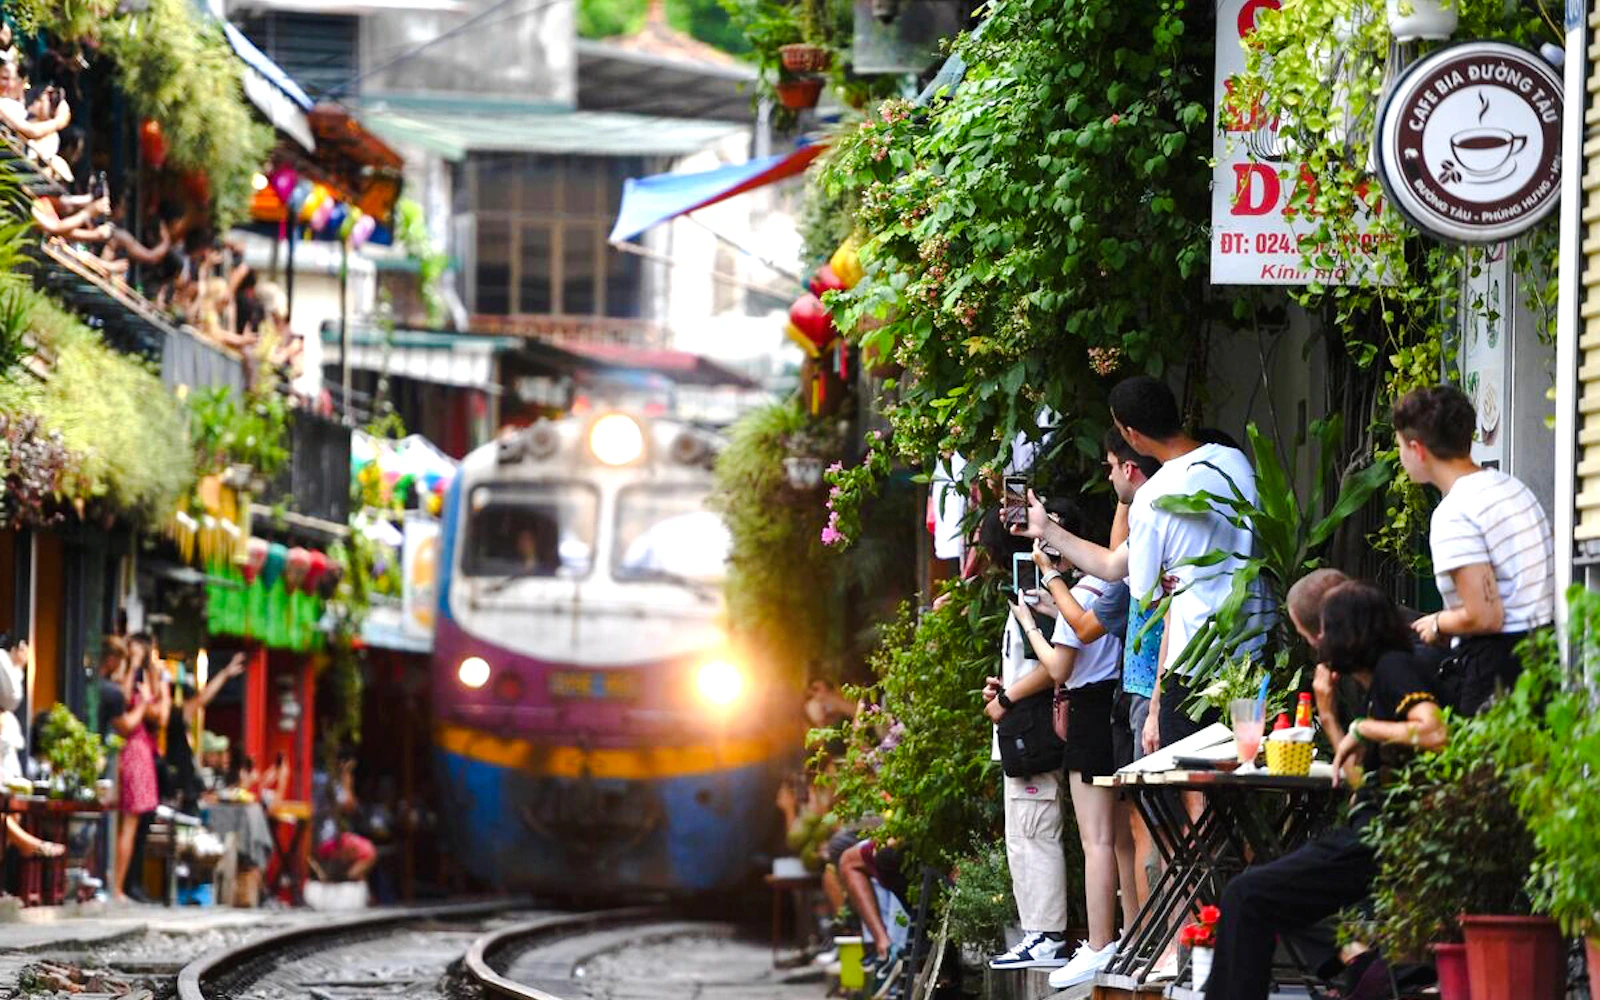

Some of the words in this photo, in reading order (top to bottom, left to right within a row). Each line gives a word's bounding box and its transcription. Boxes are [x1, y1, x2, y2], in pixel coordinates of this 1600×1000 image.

[1409, 89, 1437, 132] CAFE
[1434, 70, 1464, 95] BIA
[1467, 61, 1533, 93] ĐƯỜNG
[1531, 88, 1558, 123] TÀU
[1220, 233, 1249, 254] ĐT:
